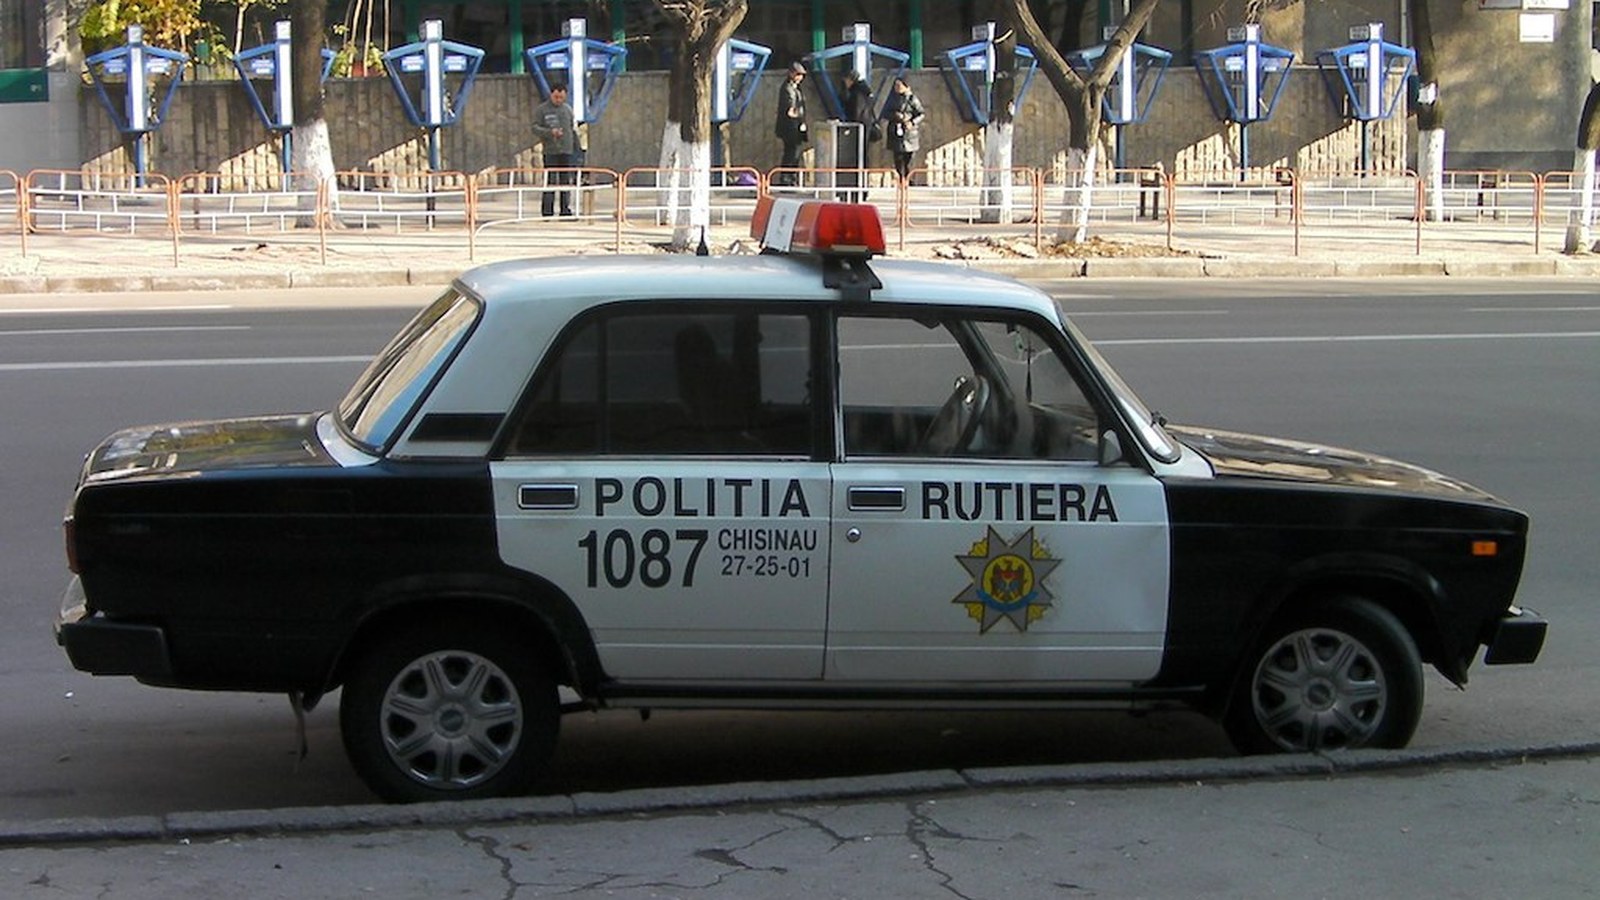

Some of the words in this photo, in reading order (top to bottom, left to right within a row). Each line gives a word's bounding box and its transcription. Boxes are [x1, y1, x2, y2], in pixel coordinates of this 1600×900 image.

[595, 476, 811, 517] POLITIA
[922, 481, 1118, 522] RUTIERA
[718, 529, 817, 550] CHISINAU
[578, 529, 709, 588] 1087
[721, 556, 810, 577] 27-25-01
